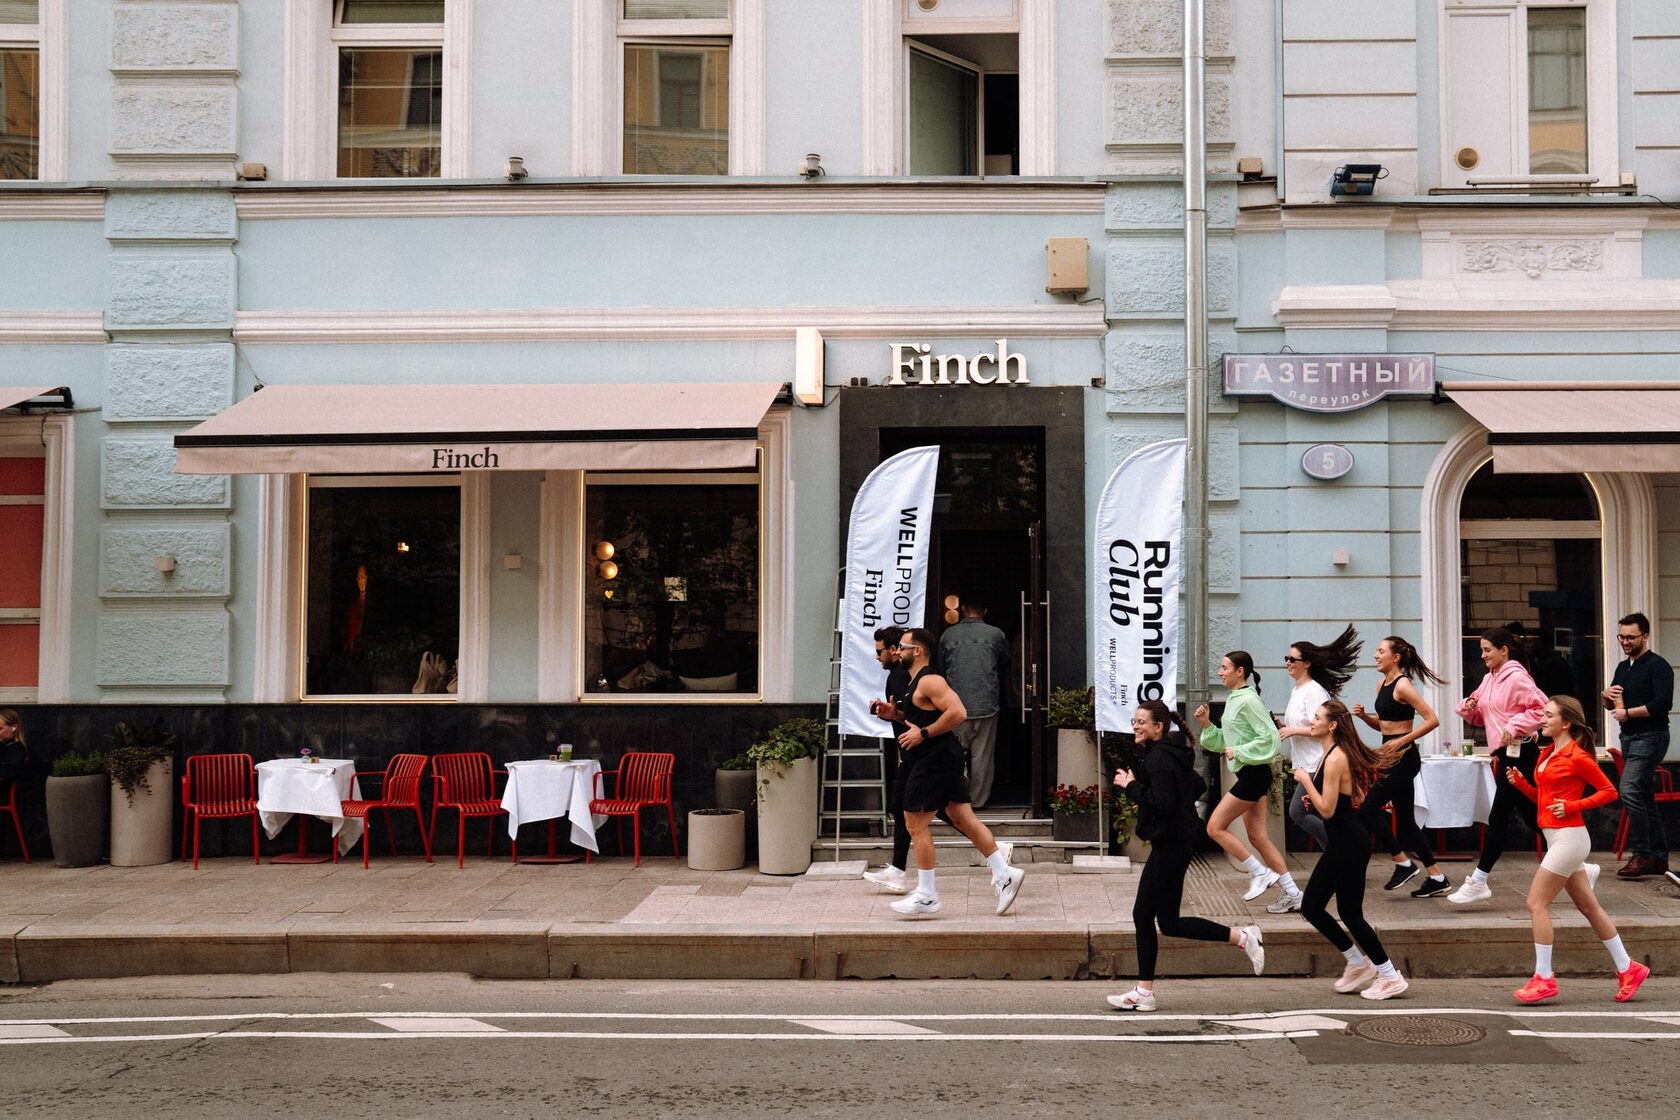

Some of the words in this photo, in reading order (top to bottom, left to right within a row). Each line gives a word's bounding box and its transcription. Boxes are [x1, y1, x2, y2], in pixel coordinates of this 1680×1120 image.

[889, 338, 1030, 386] Finch
[1234, 357, 1426, 383] ГАЗЕТНЫЙ
[1288, 388, 1371, 407] переулок
[431, 446, 500, 469] Finch
[1321, 452, 1335, 471] 5
[892, 506, 918, 629] WELLPROD
[1109, 538, 1140, 627] Club
[862, 568, 884, 627] Finch
[1137, 540, 1171, 704] Running
[1120, 684, 1128, 706] Finch
